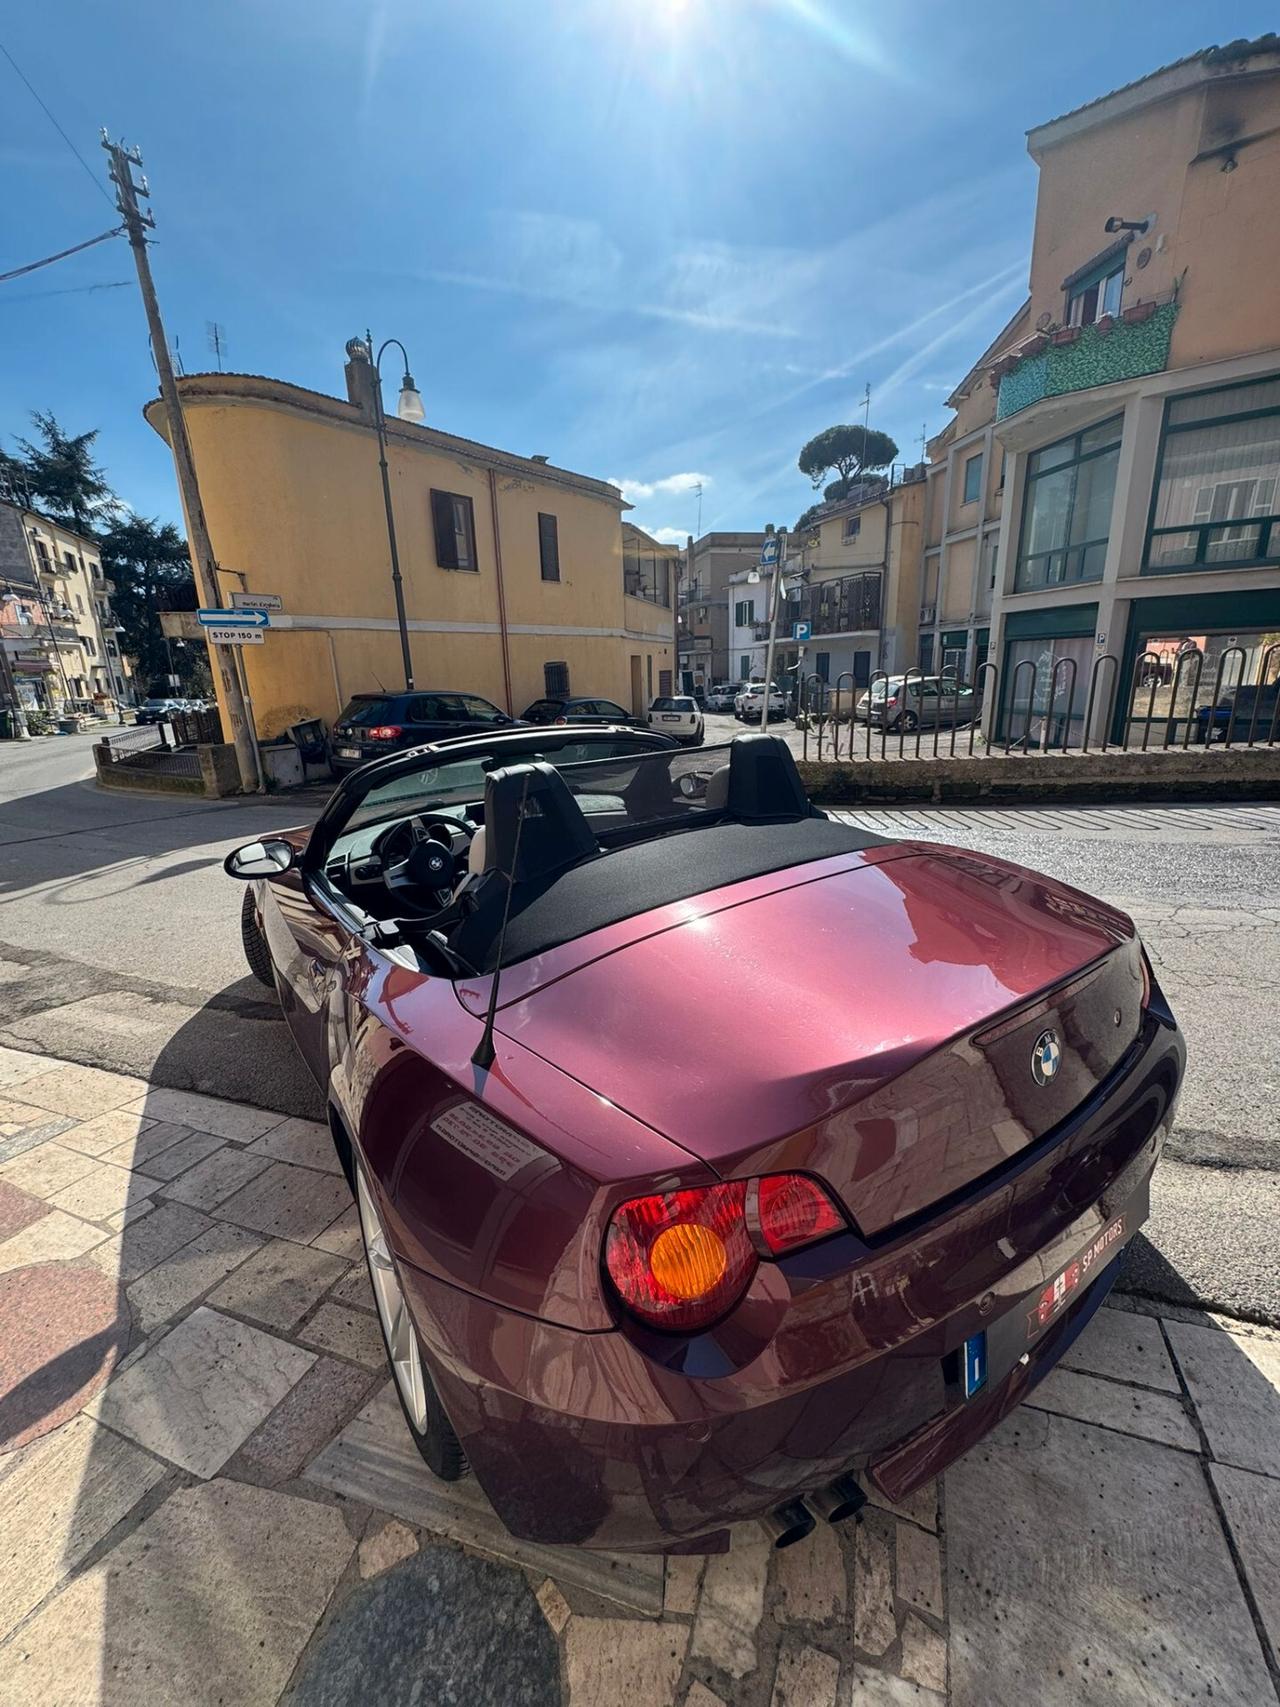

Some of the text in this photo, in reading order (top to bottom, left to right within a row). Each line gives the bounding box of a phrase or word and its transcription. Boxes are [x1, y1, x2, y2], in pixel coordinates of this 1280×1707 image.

[213, 631, 236, 639] STOP
[796, 624, 808, 639] P
[1082, 1218, 1123, 1273] SP MOTORS
